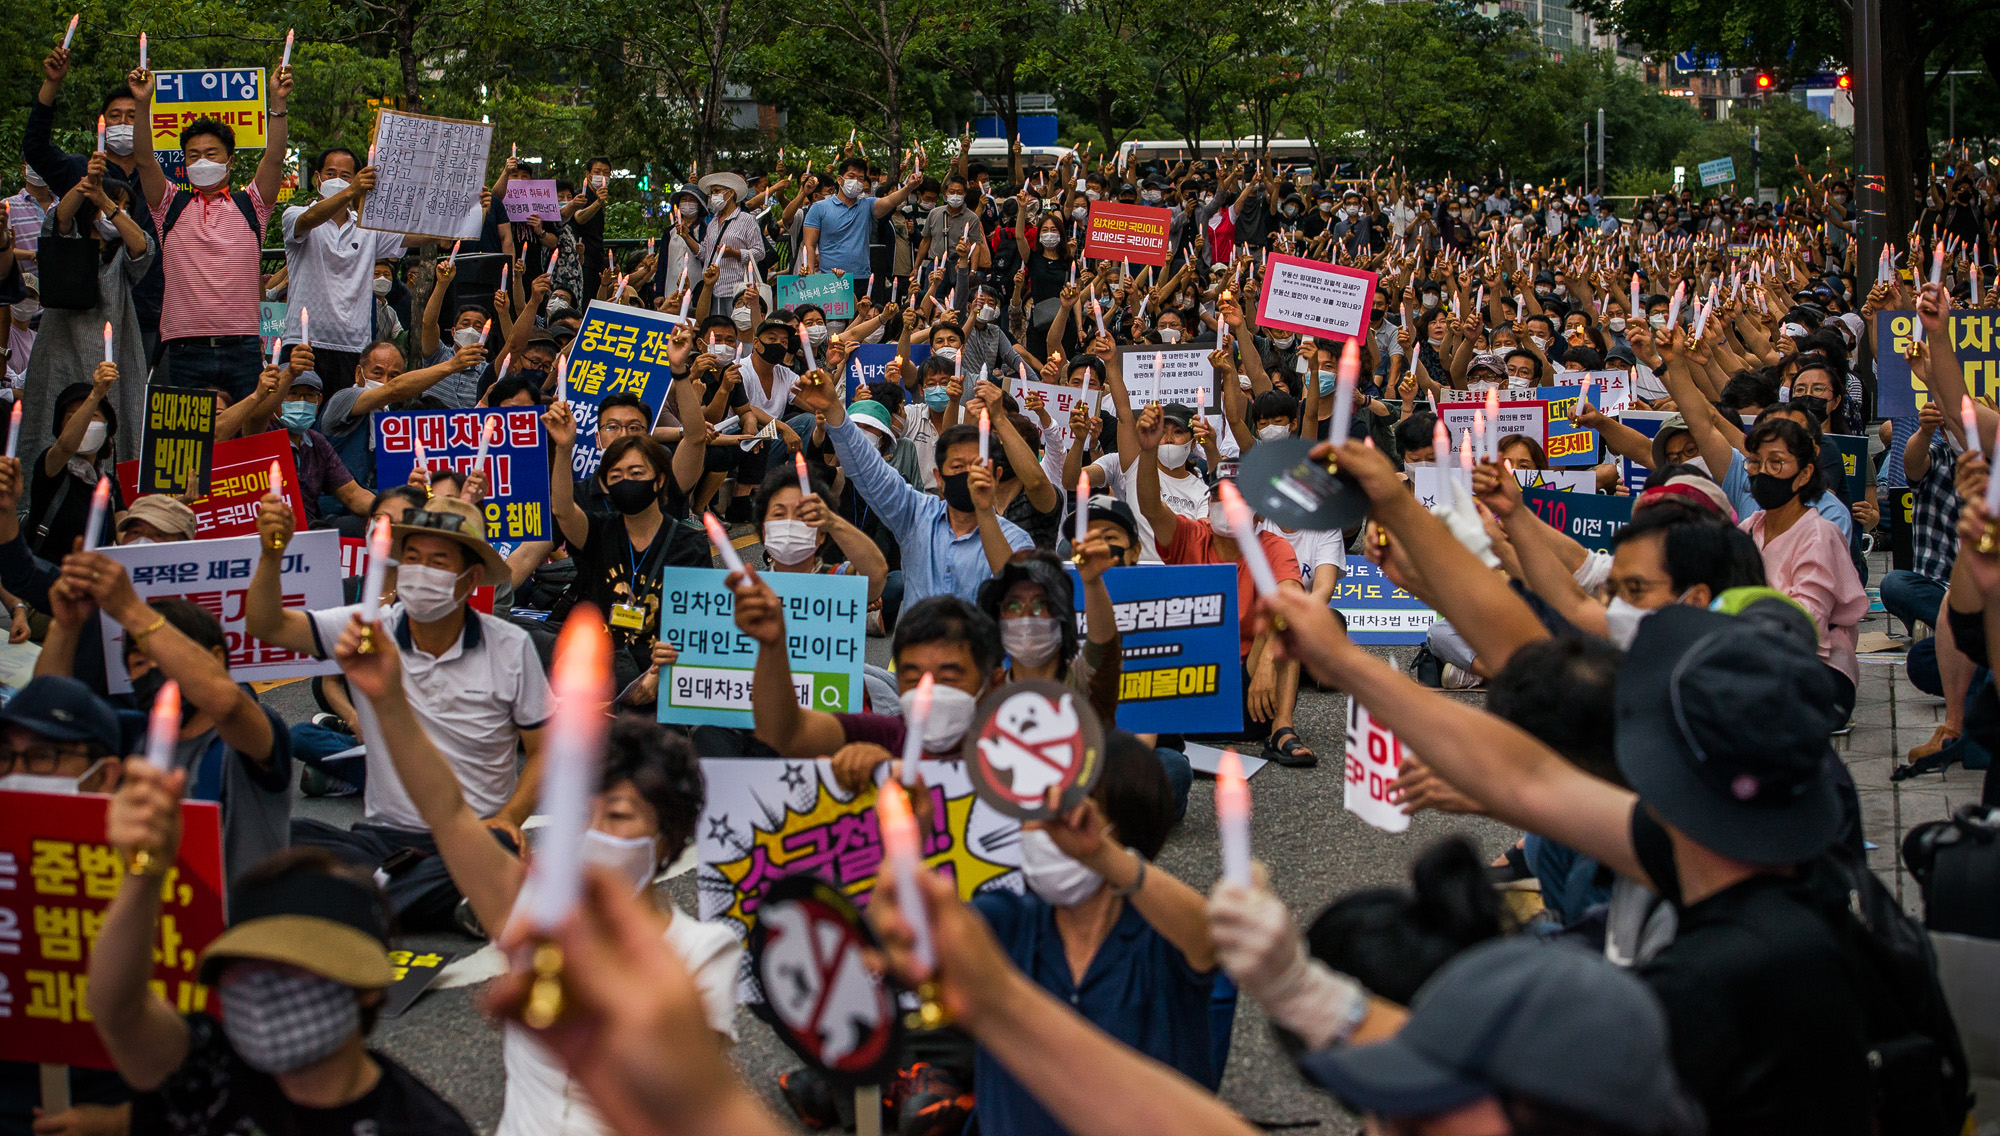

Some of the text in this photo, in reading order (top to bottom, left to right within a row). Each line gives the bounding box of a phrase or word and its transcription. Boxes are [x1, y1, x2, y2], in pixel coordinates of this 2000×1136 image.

[156, 72, 258, 100] 더 이상
[383, 115, 485, 141] 다주택자도 굶어가며
[380, 129, 481, 157] 내돈들여 세금내고
[377, 146, 479, 174] 집샀다 불로소득
[374, 163, 477, 189] 이라고 하지마라
[428, 187, 471, 204] 강제말소
[530, 188, 551, 198] 취득세
[364, 204, 421, 225] 협박하더니
[1093, 217, 1128, 231] 임차인만
[1091, 231, 1164, 249] 임대인도 국민이다!
[1281, 270, 1299, 280] 부동산
[781, 279, 807, 297] 7.10
[798, 279, 850, 301] 취득세 소급적용
[1273, 288, 1291, 298] 부동산
[822, 302, 849, 315] 위헌!
[1278, 308, 1290, 316] 누가
[581, 319, 639, 363] 중도금,
[567, 359, 609, 395] 대출
[1595, 377, 1625, 393] 말소
[151, 392, 212, 433] 임대차3법
[381, 411, 540, 454] 임대차3법
[506, 502, 543, 538] 침해
[1573, 517, 1603, 538] 이전
[132, 562, 200, 586] 목적은
[206, 558, 253, 582] 세금
[670, 590, 733, 617] 임차인
[1408, 615, 1435, 627] 반대
[789, 635, 859, 663] 민이다
